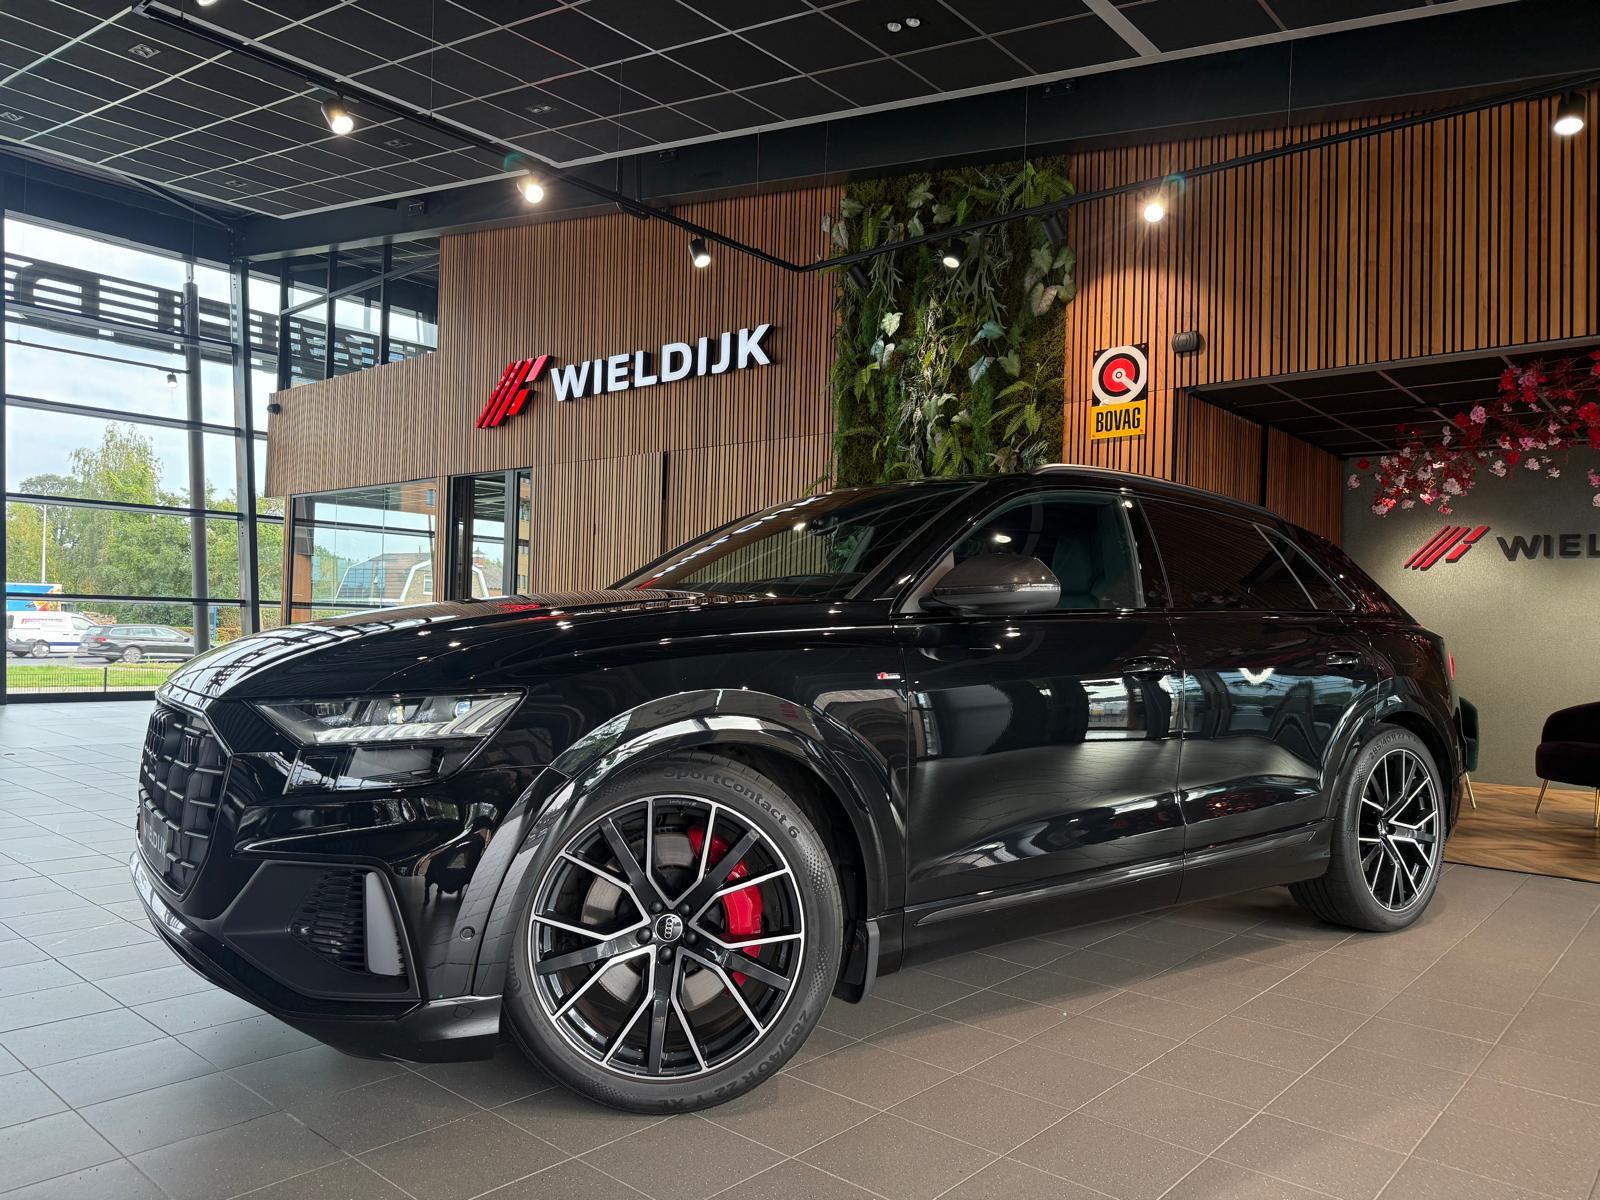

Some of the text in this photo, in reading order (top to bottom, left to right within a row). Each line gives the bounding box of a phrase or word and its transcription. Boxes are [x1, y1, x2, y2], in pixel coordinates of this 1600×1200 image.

[550, 323, 772, 402] WIELDIJK
[1095, 407, 1141, 433] BOVAG
[1497, 534, 1600, 561] WIEL
[663, 766, 801, 839] SportContact 6
